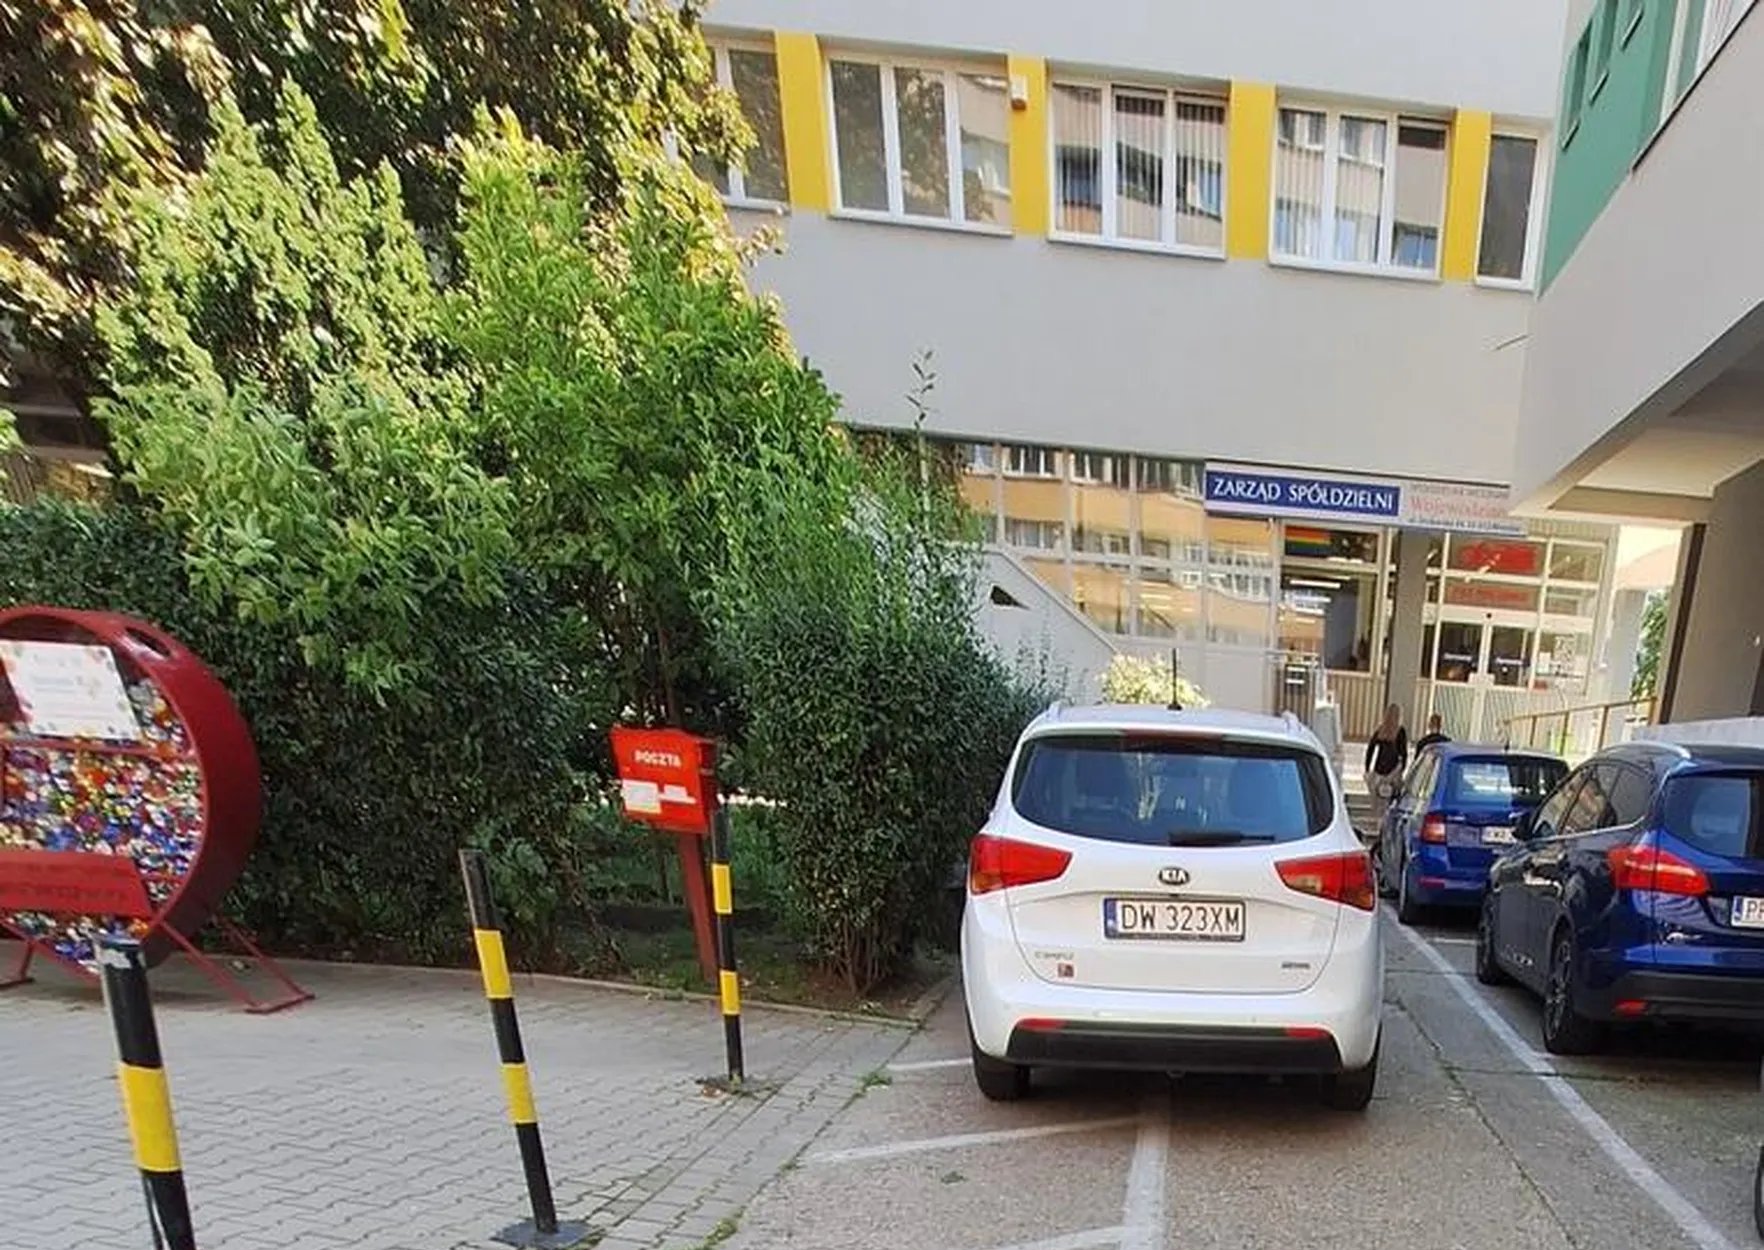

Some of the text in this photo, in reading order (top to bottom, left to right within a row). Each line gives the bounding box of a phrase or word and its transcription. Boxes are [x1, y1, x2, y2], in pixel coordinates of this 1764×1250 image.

[1213, 478, 1281, 502] ZARZĄD
[1288, 482, 1393, 510] SPÓŁDZIELNI
[1160, 868, 1189, 883] KIA
[1121, 904, 1240, 932] DW 323XM
